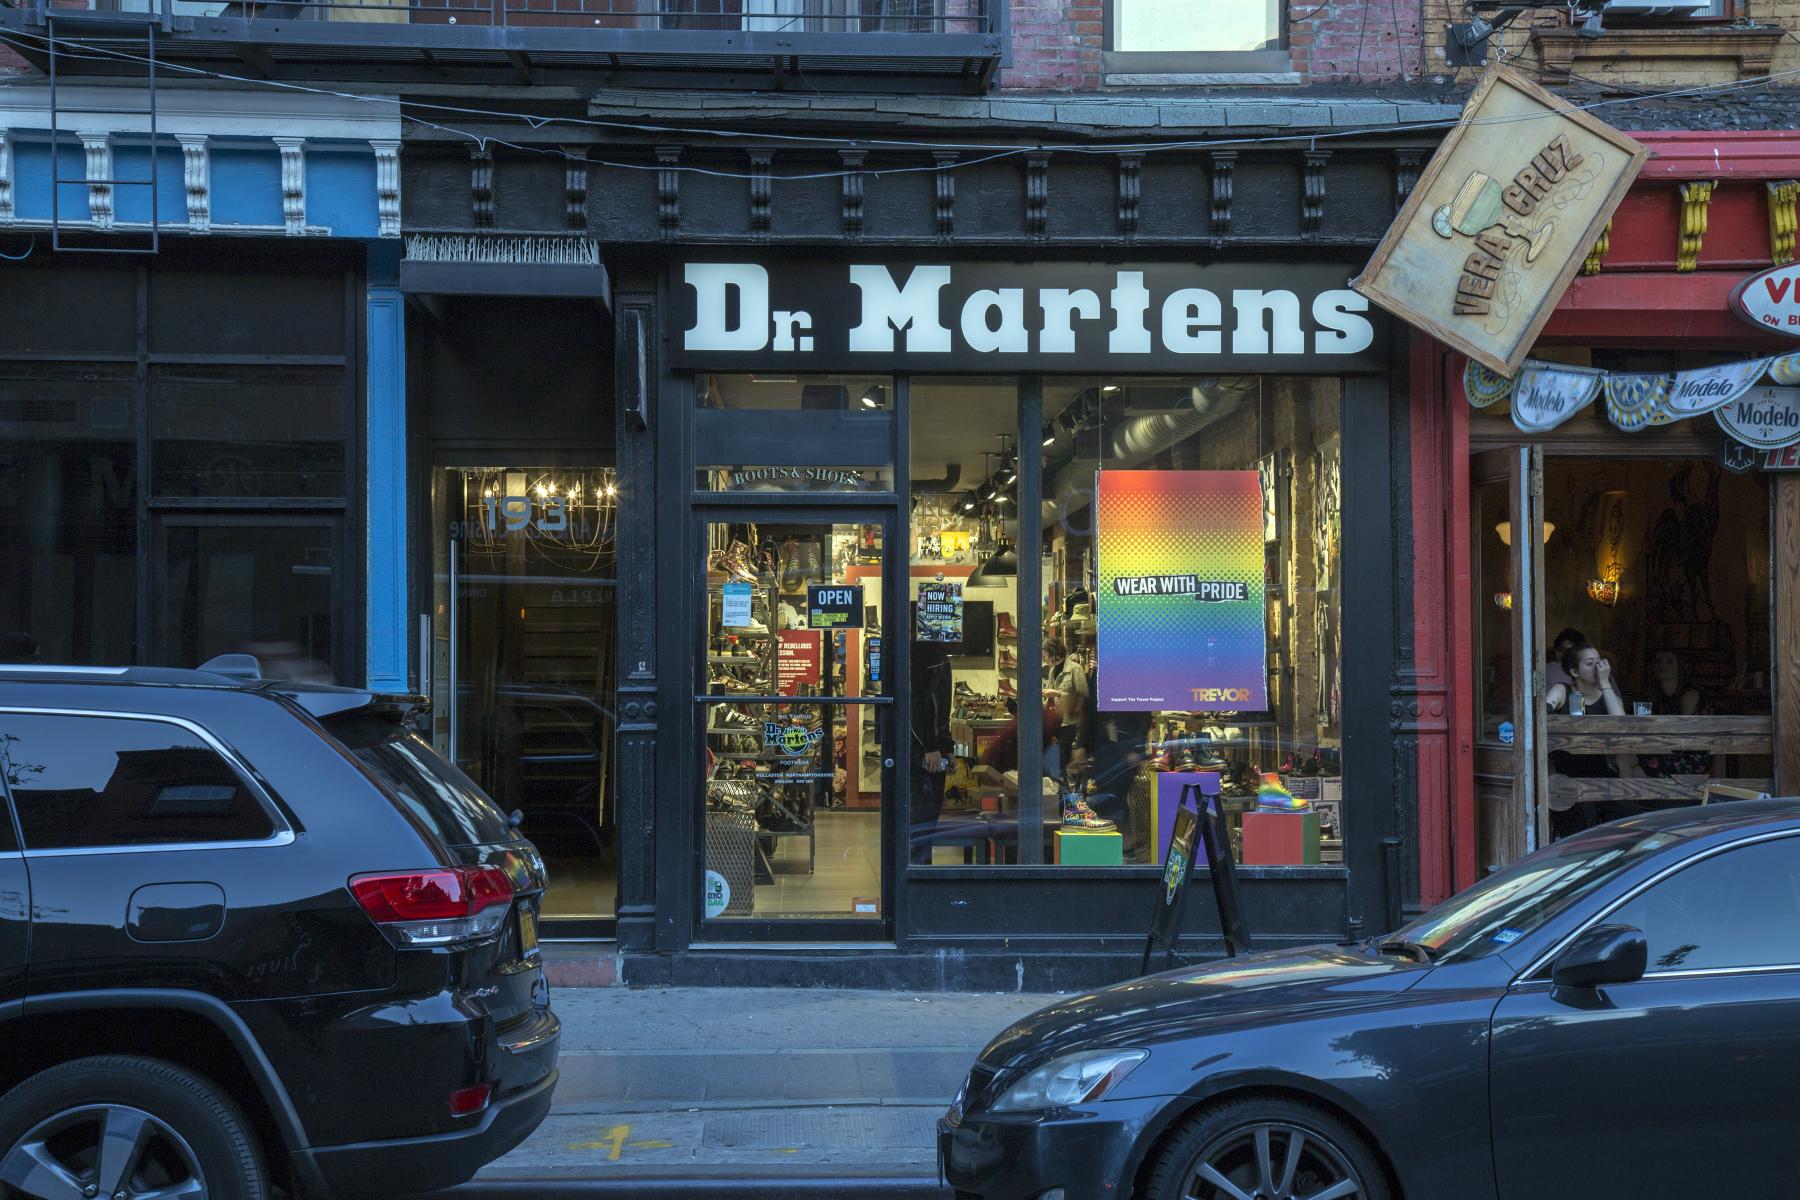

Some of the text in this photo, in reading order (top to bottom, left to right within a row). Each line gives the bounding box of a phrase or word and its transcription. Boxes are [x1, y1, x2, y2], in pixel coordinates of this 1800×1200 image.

[1453, 133, 1584, 315] VERA CRUZ
[849, 264, 1374, 354] Martens
[1762, 314, 1780, 326] ON
[1679, 378, 1734, 398] Modelo
[1524, 387, 1565, 412] Modelo
[1737, 402, 1800, 428] Modelo
[733, 466, 858, 486] BOOTS & SHOES
[482, 495, 567, 531] 193
[1117, 576, 1195, 594] WEAR WITH
[1201, 582, 1244, 599] PRIDE
[818, 590, 852, 605] OPEN
[927, 592, 945, 601] NOW
[927, 604, 954, 613] HIRING
[1192, 688, 1249, 702] TREVOR
[765, 727, 824, 745] Martens
